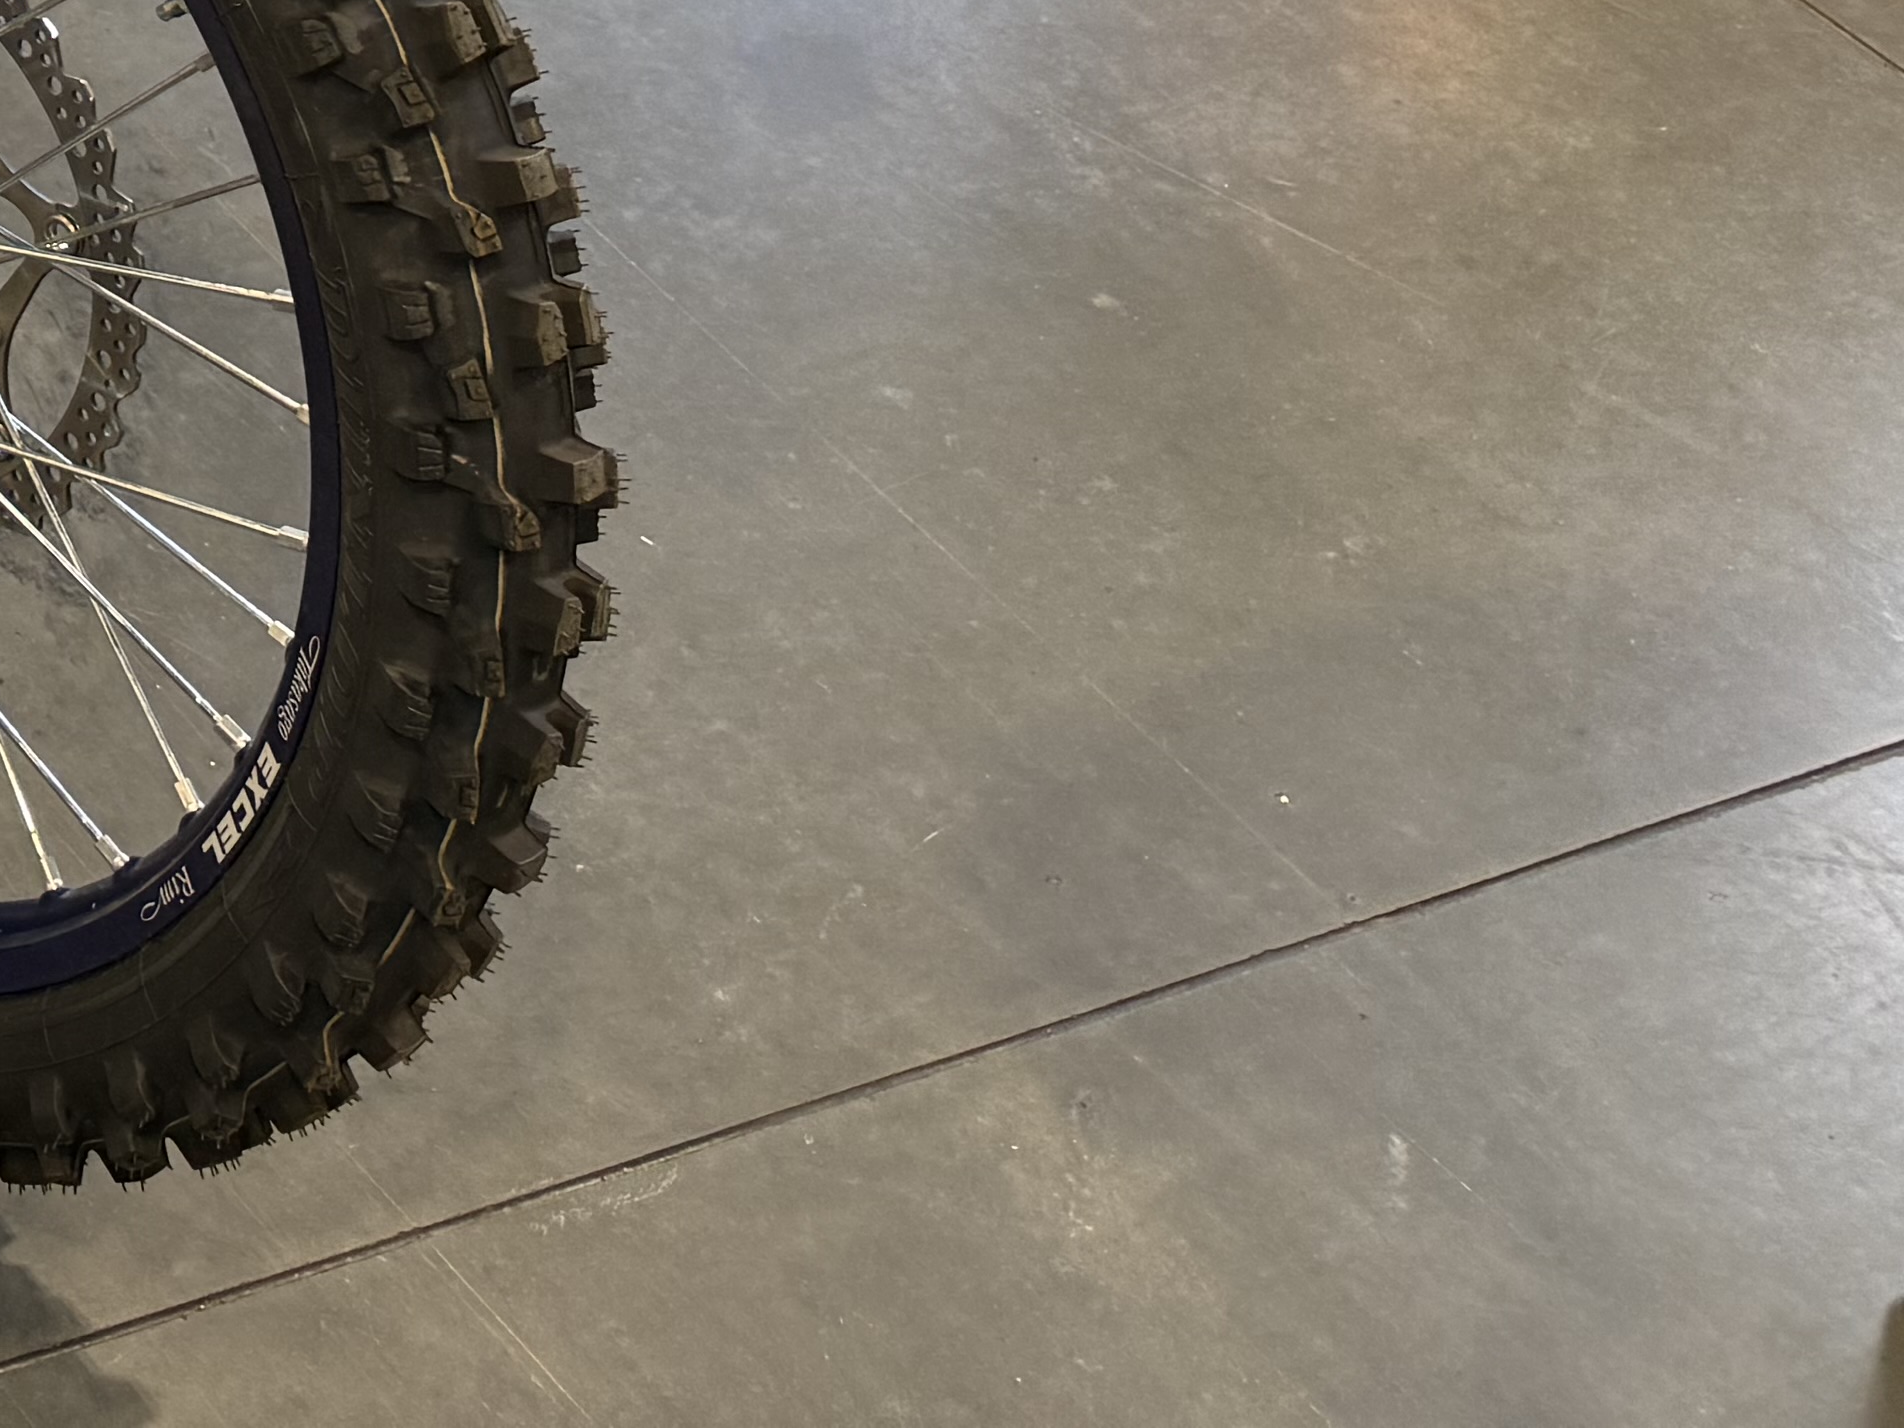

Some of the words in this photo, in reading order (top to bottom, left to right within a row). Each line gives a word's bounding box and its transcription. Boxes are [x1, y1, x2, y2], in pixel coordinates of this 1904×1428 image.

[276, 634, 321, 742] Takasago
[201, 740, 284, 867] EXCEL
[139, 864, 194, 923] Rim
